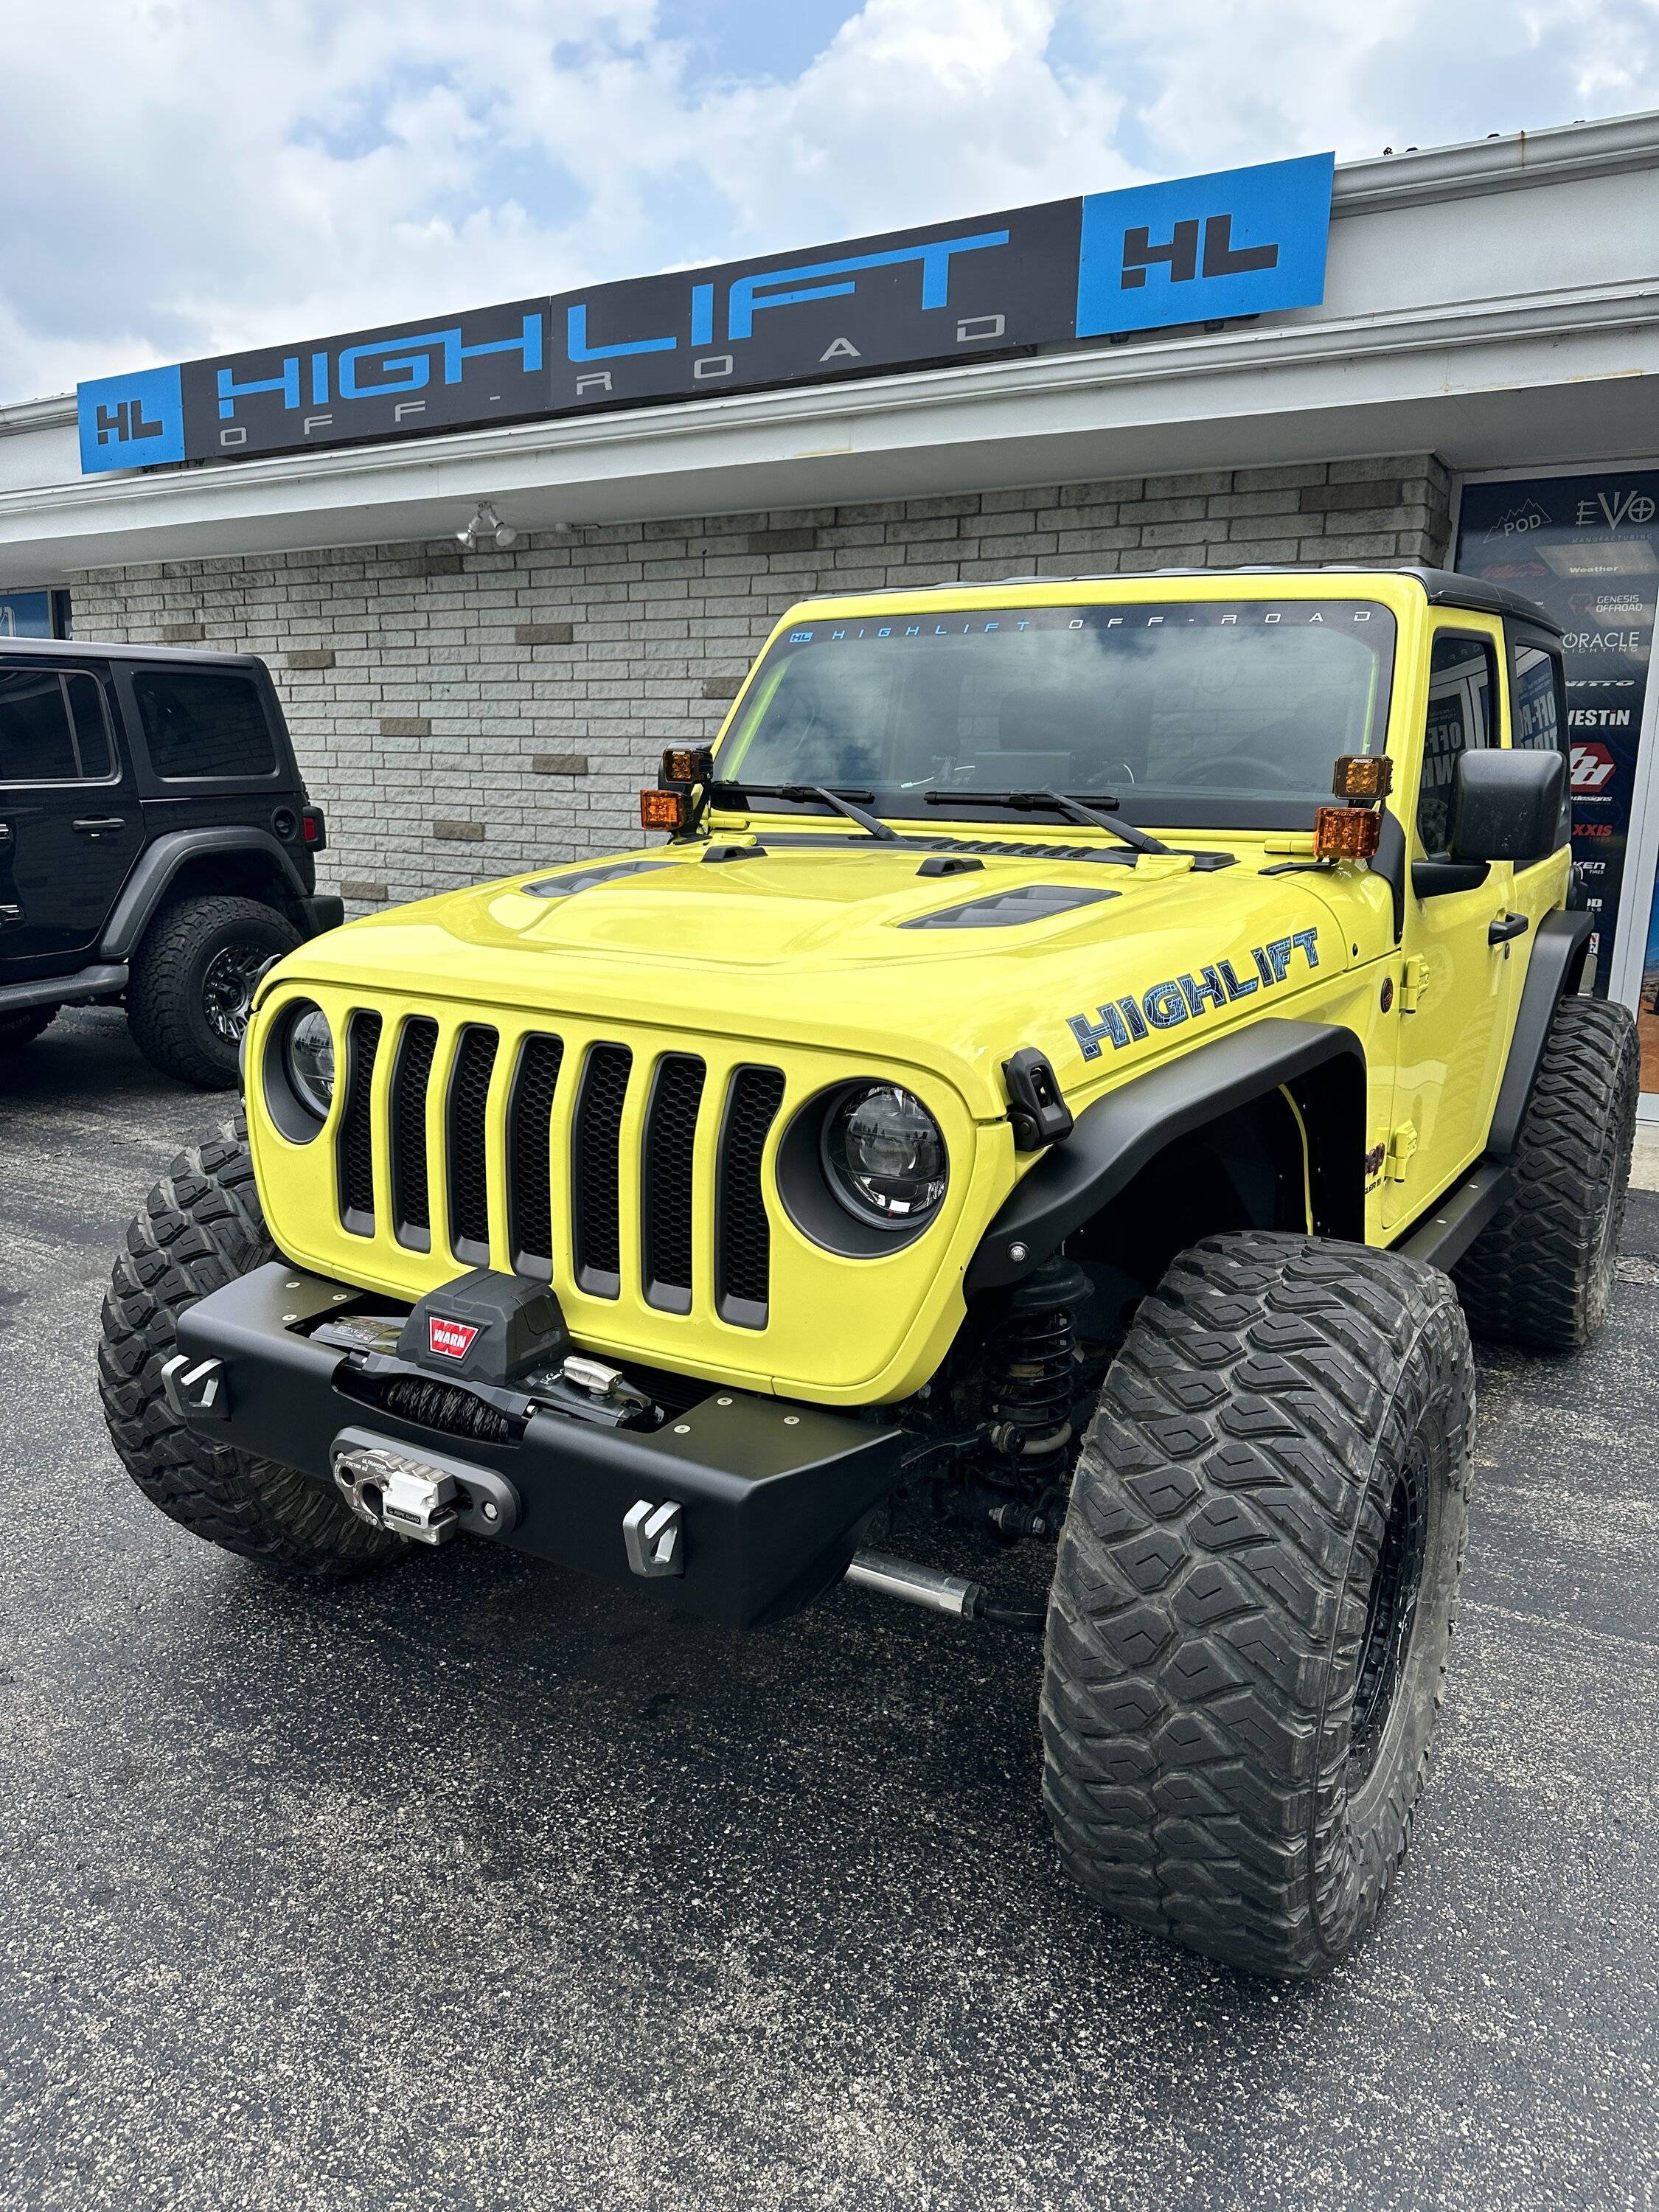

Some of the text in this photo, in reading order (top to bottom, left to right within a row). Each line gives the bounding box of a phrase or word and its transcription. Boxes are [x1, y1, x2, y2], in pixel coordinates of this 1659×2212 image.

[1121, 214, 1279, 291] HL
[216, 229, 1010, 420] HIGHLIFT
[97, 400, 163, 445] HL
[1503, 514, 1542, 537] POD
[1596, 594, 1640, 604] GENESIS
[1596, 603, 1643, 613] OFFROAD
[831, 622, 1030, 641] HIGHLIFT
[1562, 631, 1640, 648] ORACLE
[1572, 824, 1613, 837] XXIS
[1065, 926, 1320, 1062] HIGHLIFT
[434, 1329, 467, 1349] WARN
